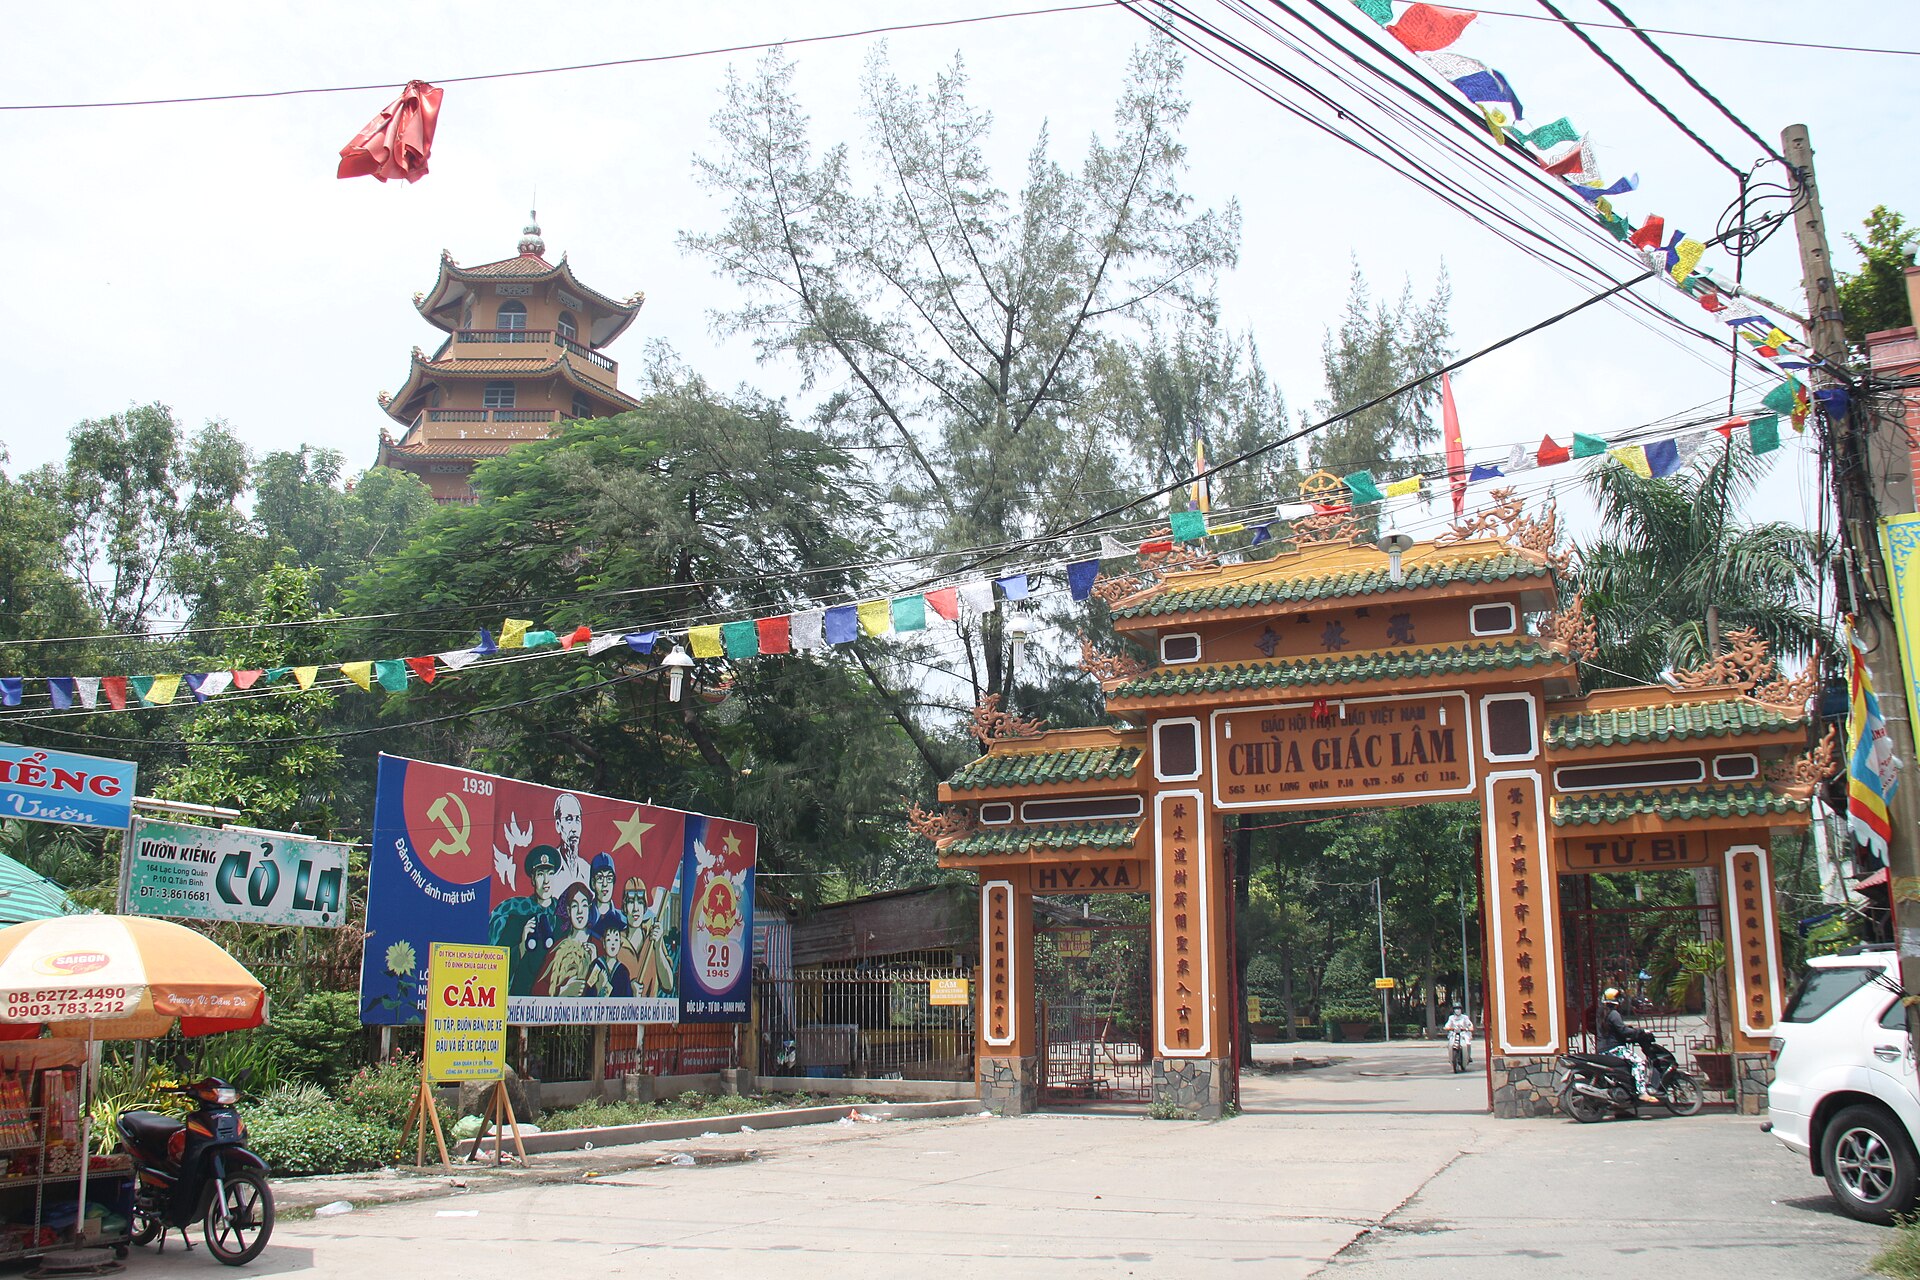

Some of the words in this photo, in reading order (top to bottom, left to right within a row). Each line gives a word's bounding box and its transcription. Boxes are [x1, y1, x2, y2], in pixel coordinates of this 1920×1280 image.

[1370, 705, 1394, 726] VIỆT
[1401, 705, 1426, 722] NAM
[1228, 735, 1305, 776] CHÙA
[1312, 728, 1382, 771] GIÁC
[1389, 724, 1457, 767] LÂM
[463, 776, 493, 796] 1930
[1280, 781, 1300, 792] LONG
[6, 793, 98, 823] Vườn
[141, 840, 178, 860] VƯỜN
[180, 842, 217, 864] KIỂNG
[160, 866, 172, 874] Lạc
[173, 867, 190, 876] Long
[395, 837, 414, 873] Đảng
[409, 868, 427, 889] như
[424, 882, 441, 900] ánh
[442, 891, 460, 906] mặt
[460, 888, 476, 903] trời
[215, 842, 281, 907] CỎ
[292, 859, 342, 923] LẠ
[161, 888, 210, 901] 3.8616681
[56, 954, 105, 965] SAIGON
[707, 944, 730, 968] 2.9
[706, 969, 730, 978] 1945
[8, 987, 126, 1004] 08.6272.4490
[443, 975, 497, 1007] CẤM
[7, 1001, 125, 1018] 0903.783.212
[606, 1005, 620, 1021] THEO
[467, 1040, 474, 1051] XE
